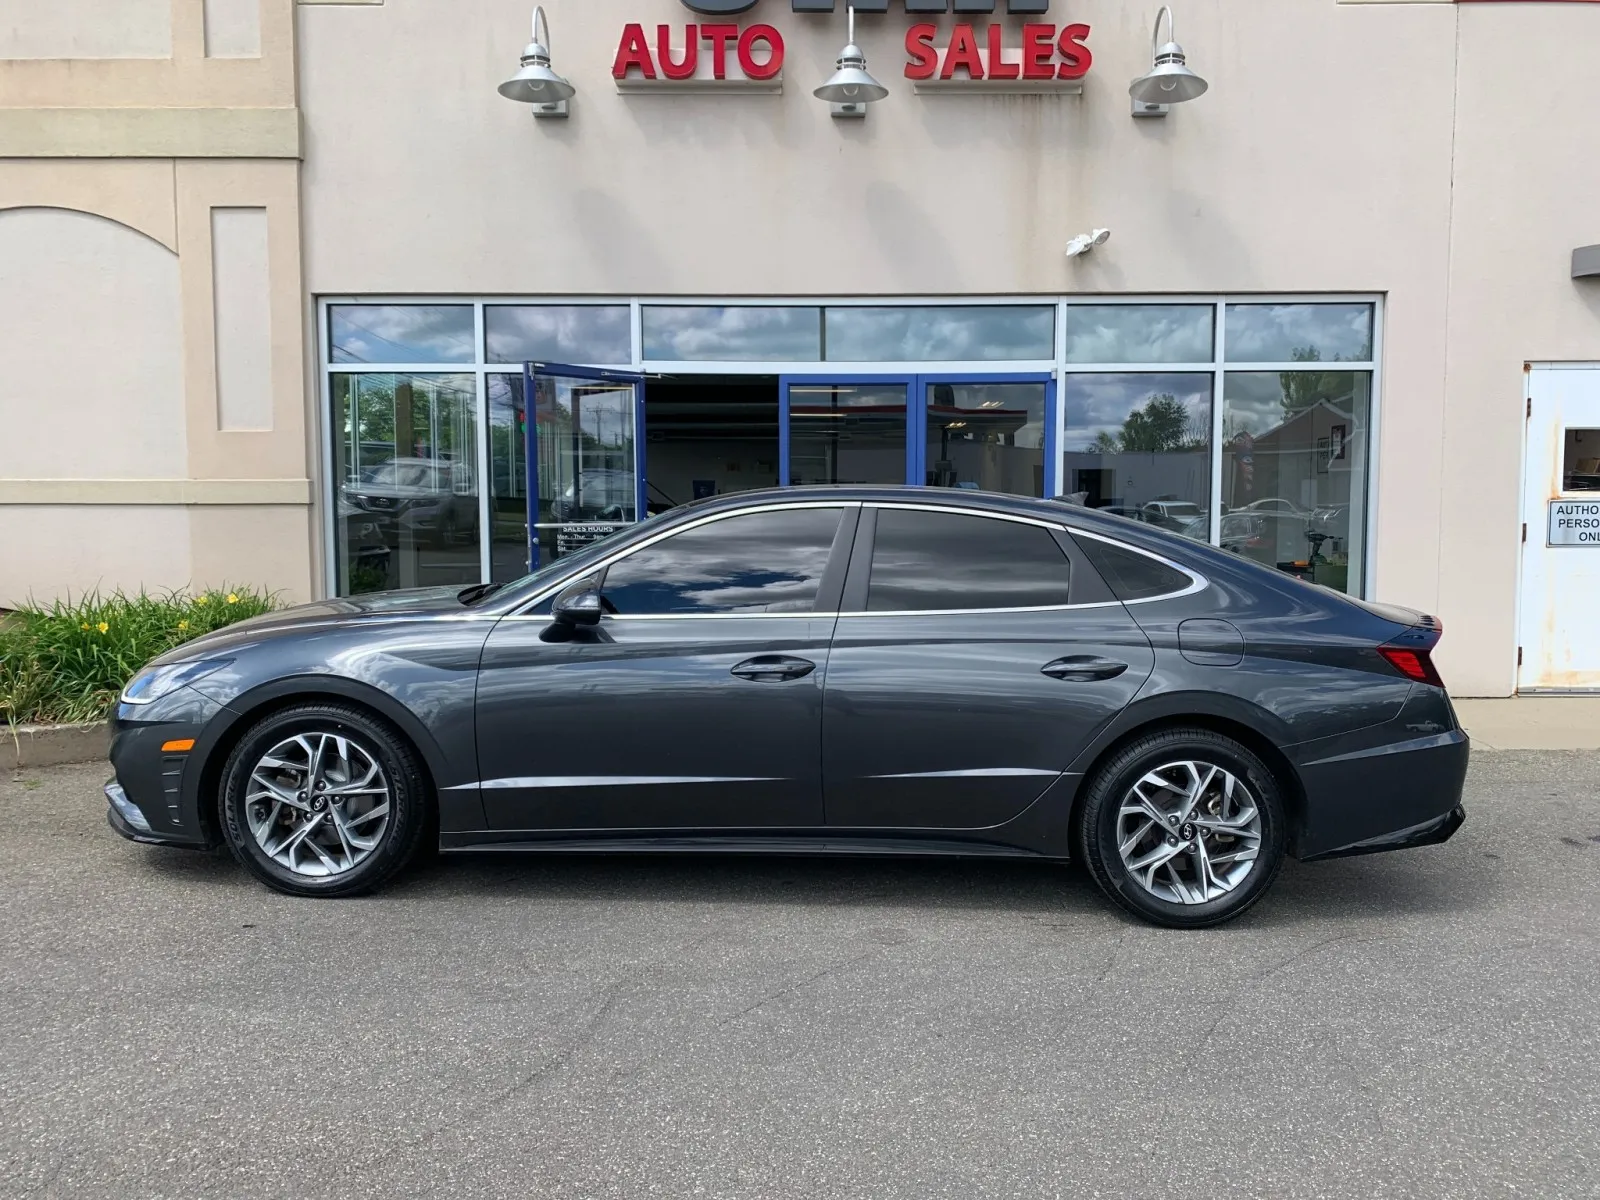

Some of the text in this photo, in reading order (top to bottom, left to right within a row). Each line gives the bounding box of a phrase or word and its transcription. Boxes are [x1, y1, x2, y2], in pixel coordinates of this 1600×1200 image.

[613, 23, 1093, 80] AUTO SALES
[1556, 505, 1600, 515] AUTHO
[1558, 518, 1600, 528] PERSO
